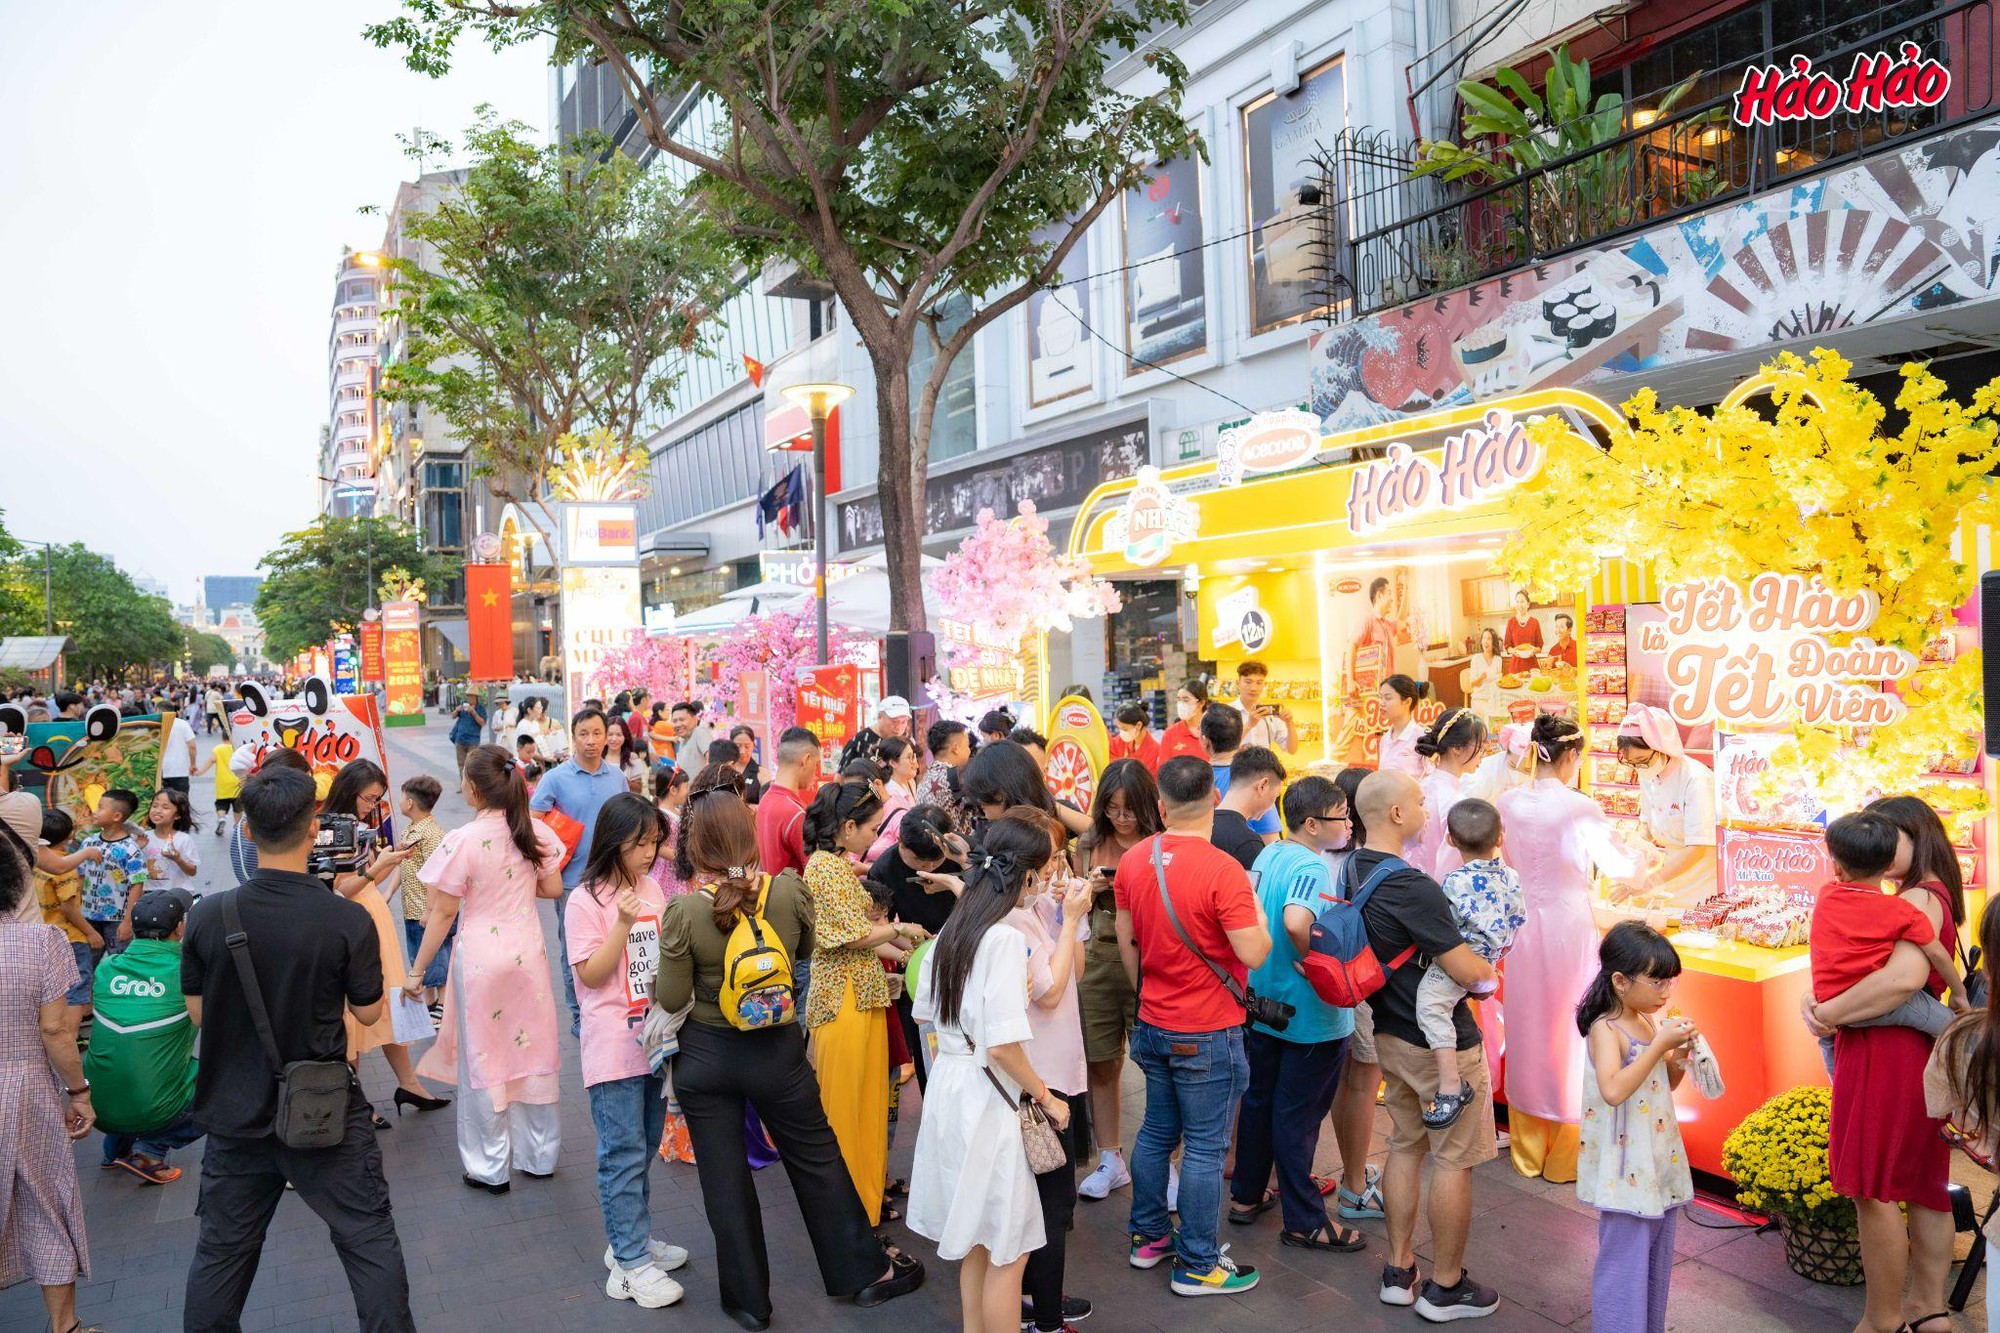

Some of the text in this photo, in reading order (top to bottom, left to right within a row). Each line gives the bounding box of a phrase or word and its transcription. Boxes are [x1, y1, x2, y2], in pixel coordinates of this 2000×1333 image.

[1276, 118, 1322, 149] GAMMA
[1347, 410, 1537, 533] Hảo Hảo
[580, 527, 631, 540] HDBank
[1664, 576, 1865, 635] Tết Hảo
[1641, 626, 1668, 650] là
[1787, 638, 1904, 677] Đoàn
[1667, 642, 1785, 720] Tết
[1795, 682, 1893, 724] Viên
[293, 719, 361, 768] Hảo
[1730, 750, 1769, 776] Hảo
[1733, 846, 1816, 873] Hảo Hảo
[638, 945, 647, 958] a
[110, 975, 166, 998] Grab
